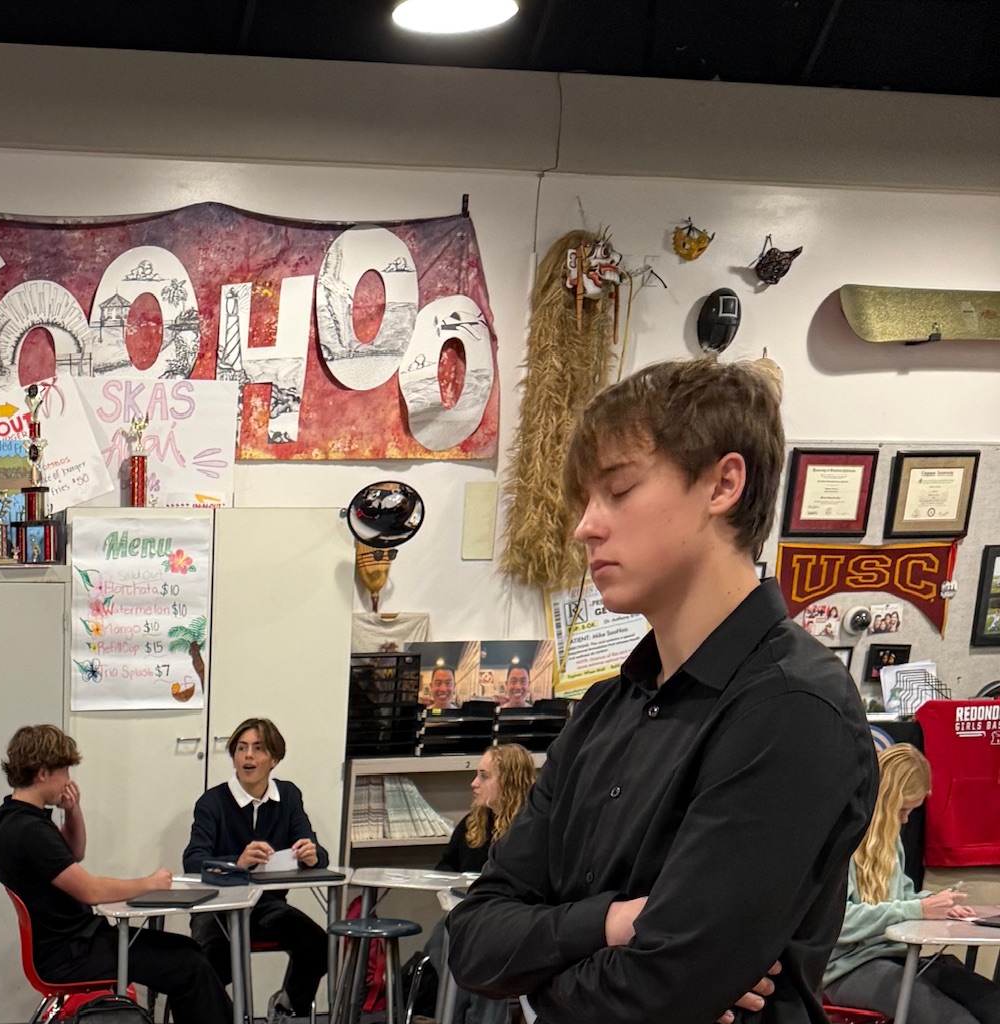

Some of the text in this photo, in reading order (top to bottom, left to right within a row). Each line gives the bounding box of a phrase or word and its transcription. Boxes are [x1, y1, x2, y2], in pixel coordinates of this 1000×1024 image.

[96, 380, 196, 423] SKAS
[42, 456, 71, 471] OMBOS
[103, 530, 173, 560] Menu
[791, 553, 939, 603] USC
[160, 582, 180, 596] $10
[102, 601, 187, 617] Watermelon $10
[103, 620, 160, 640] Mango $10
[145, 641, 164, 653] $15
[570, 635, 590, 644] ATIENT:
[98, 664, 170, 680] Trio Splash $7
[956, 705, 1000, 721] REDOND
[955, 722, 982, 731] GIRLS
